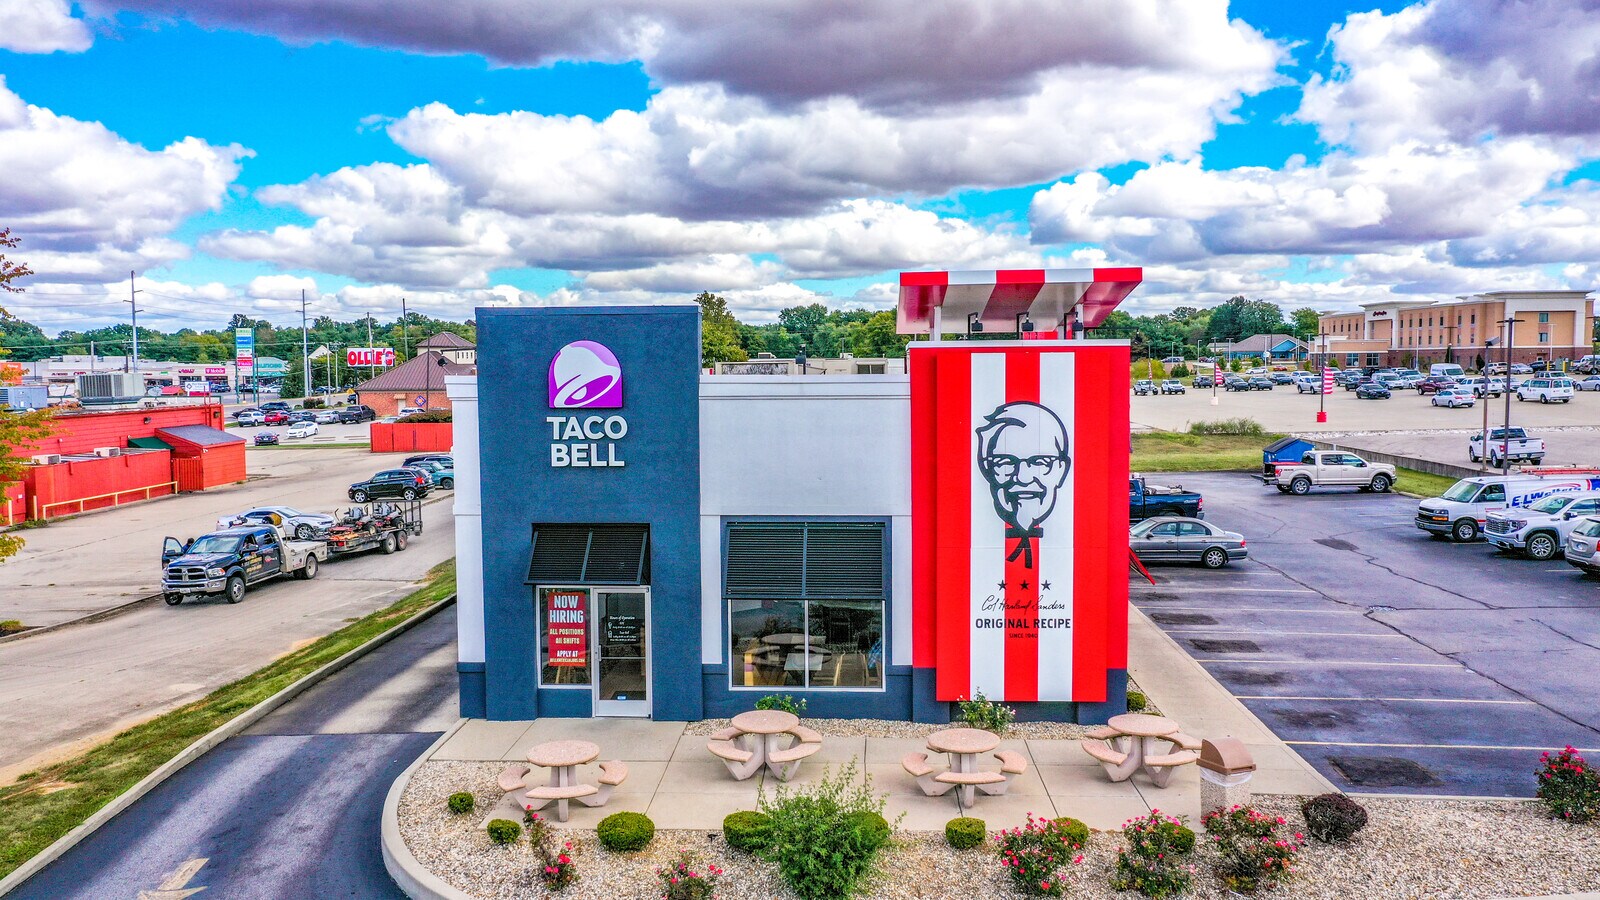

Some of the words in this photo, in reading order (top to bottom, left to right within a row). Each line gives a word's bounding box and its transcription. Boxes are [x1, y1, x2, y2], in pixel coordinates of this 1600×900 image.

[546, 415, 628, 440] TACO
[550, 443, 625, 467] BELL
[553, 595, 579, 608] NOW
[549, 610, 584, 623] HIRING
[975, 618, 1030, 629] ORIGINAL
[1033, 618, 1071, 629] RECIPE
[563, 637, 580, 645] SHIFTS
[556, 650, 572, 658] APPLY
[572, 650, 579, 658] AT
